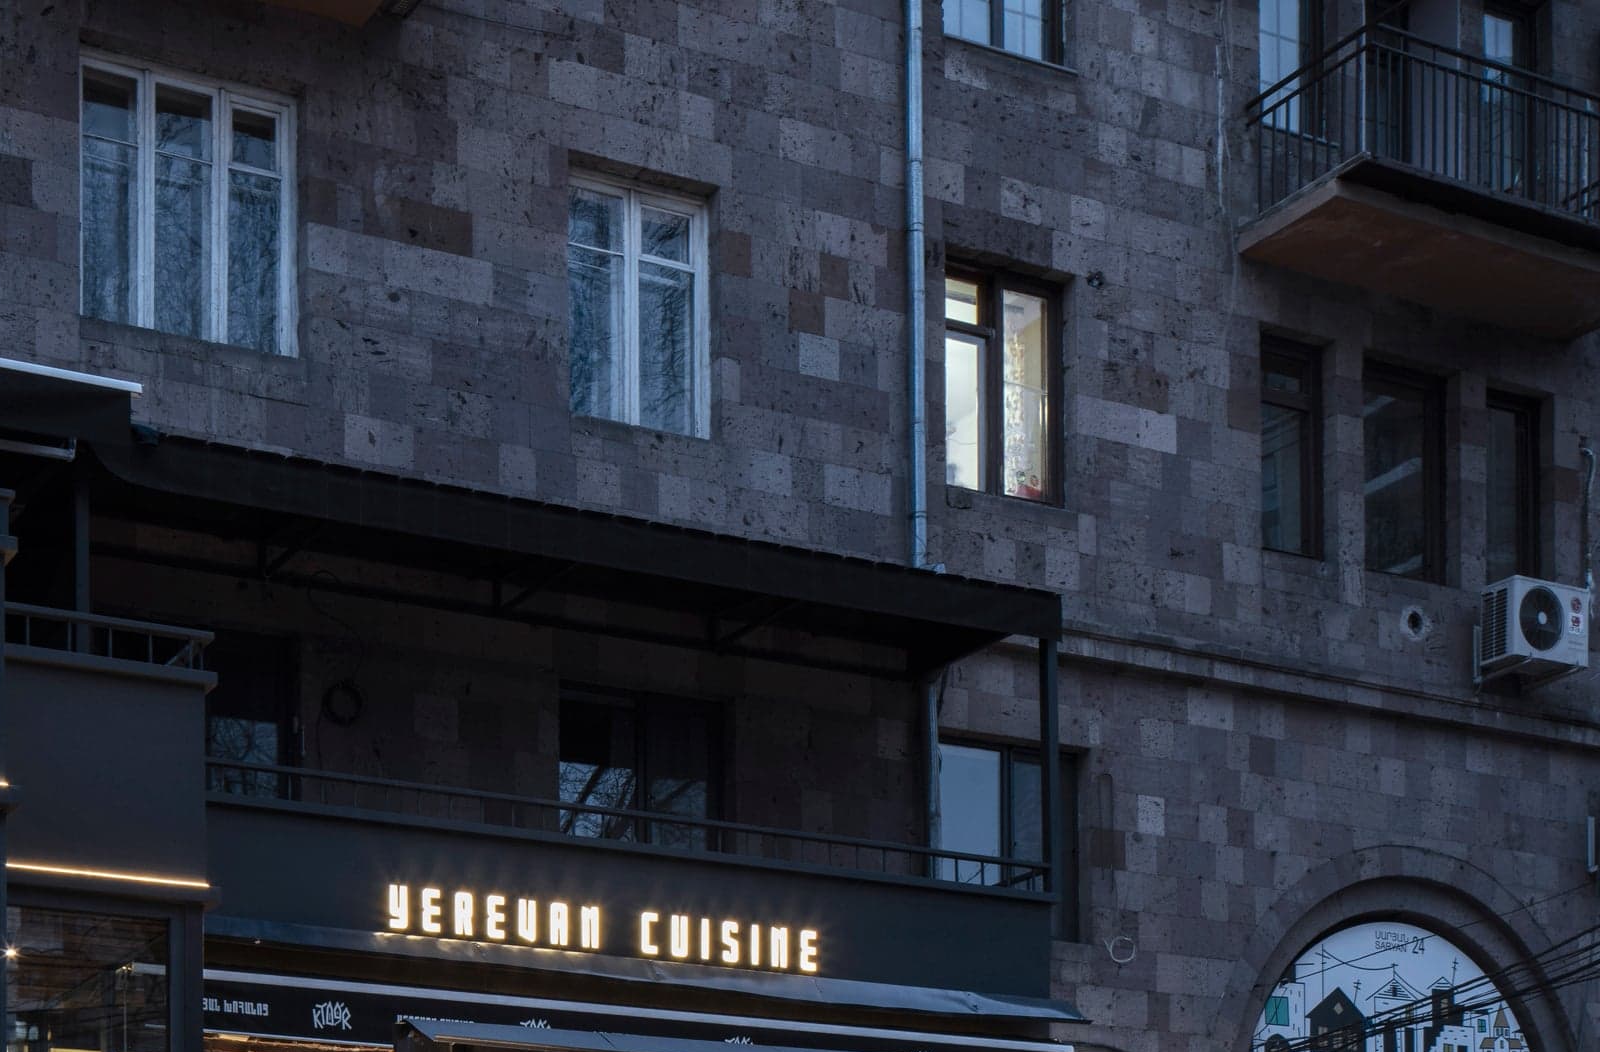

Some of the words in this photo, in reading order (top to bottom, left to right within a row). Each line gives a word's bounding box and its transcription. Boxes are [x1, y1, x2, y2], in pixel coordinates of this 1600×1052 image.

[388, 884, 600, 949] YEREVAN
[640, 911, 818, 972] CUISINE
[1412, 936, 1425, 954] 24
